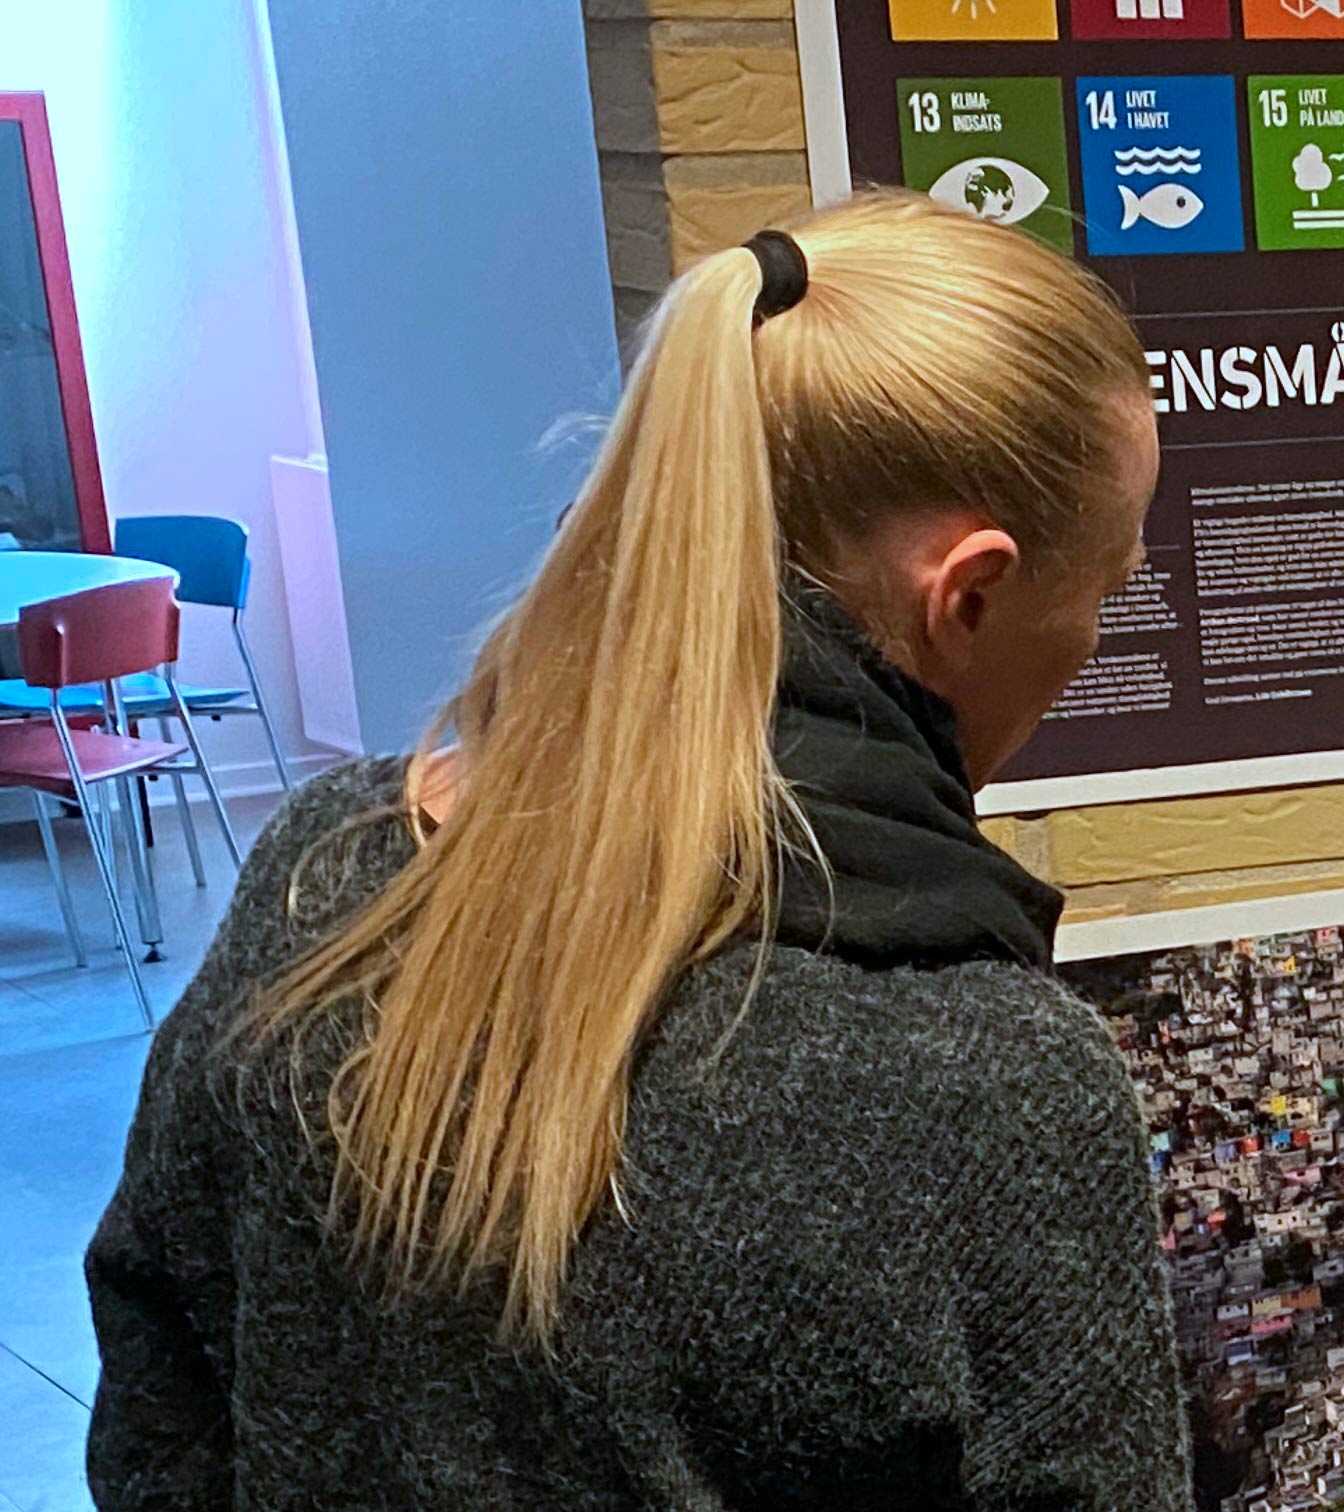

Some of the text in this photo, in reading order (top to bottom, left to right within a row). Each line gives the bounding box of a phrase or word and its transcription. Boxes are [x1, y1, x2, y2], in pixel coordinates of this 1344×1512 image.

[951, 92, 991, 112] KLIMA-
[1126, 89, 1157, 109] LIVET
[1259, 88, 1288, 128] 15
[1298, 89, 1327, 107] LIVET
[909, 92, 941, 133] 13
[1085, 90, 1117, 130] 14
[1134, 111, 1170, 129] HAVET
[1319, 108, 1344, 127] LAND
[952, 113, 1002, 133] INDSATS
